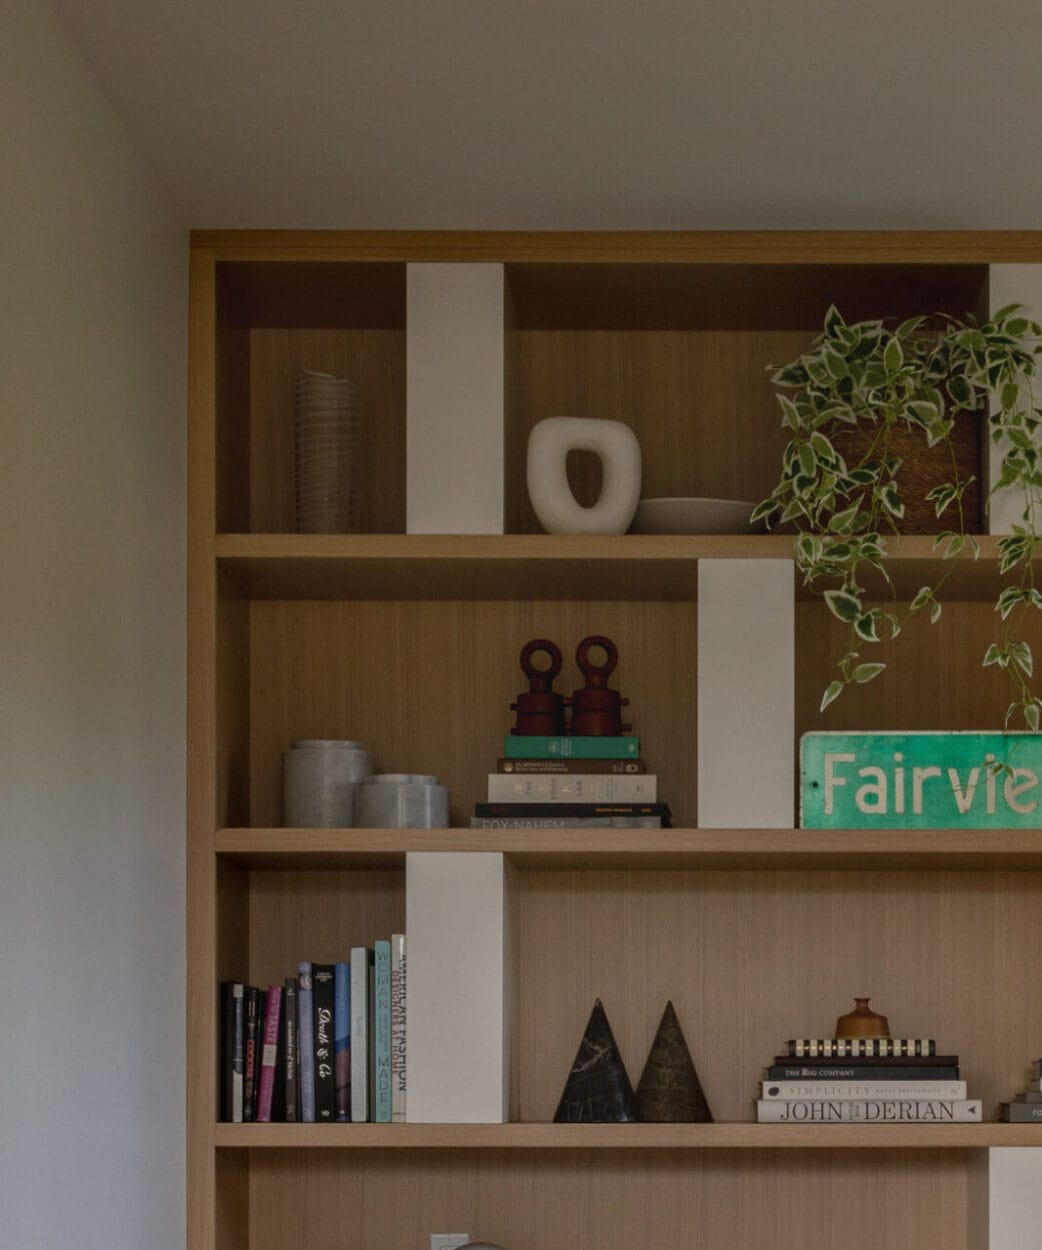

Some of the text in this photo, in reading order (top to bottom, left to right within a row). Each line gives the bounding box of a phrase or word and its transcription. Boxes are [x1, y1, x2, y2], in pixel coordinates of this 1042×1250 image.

[317, 1007, 332, 1044] Death
[318, 1063, 332, 1080] Co
[377, 1056, 391, 1104] MADE
[788, 1086, 872, 1096] SIMPLICITY
[780, 1101, 843, 1121] JOHN
[865, 1101, 955, 1121] DERIAN
